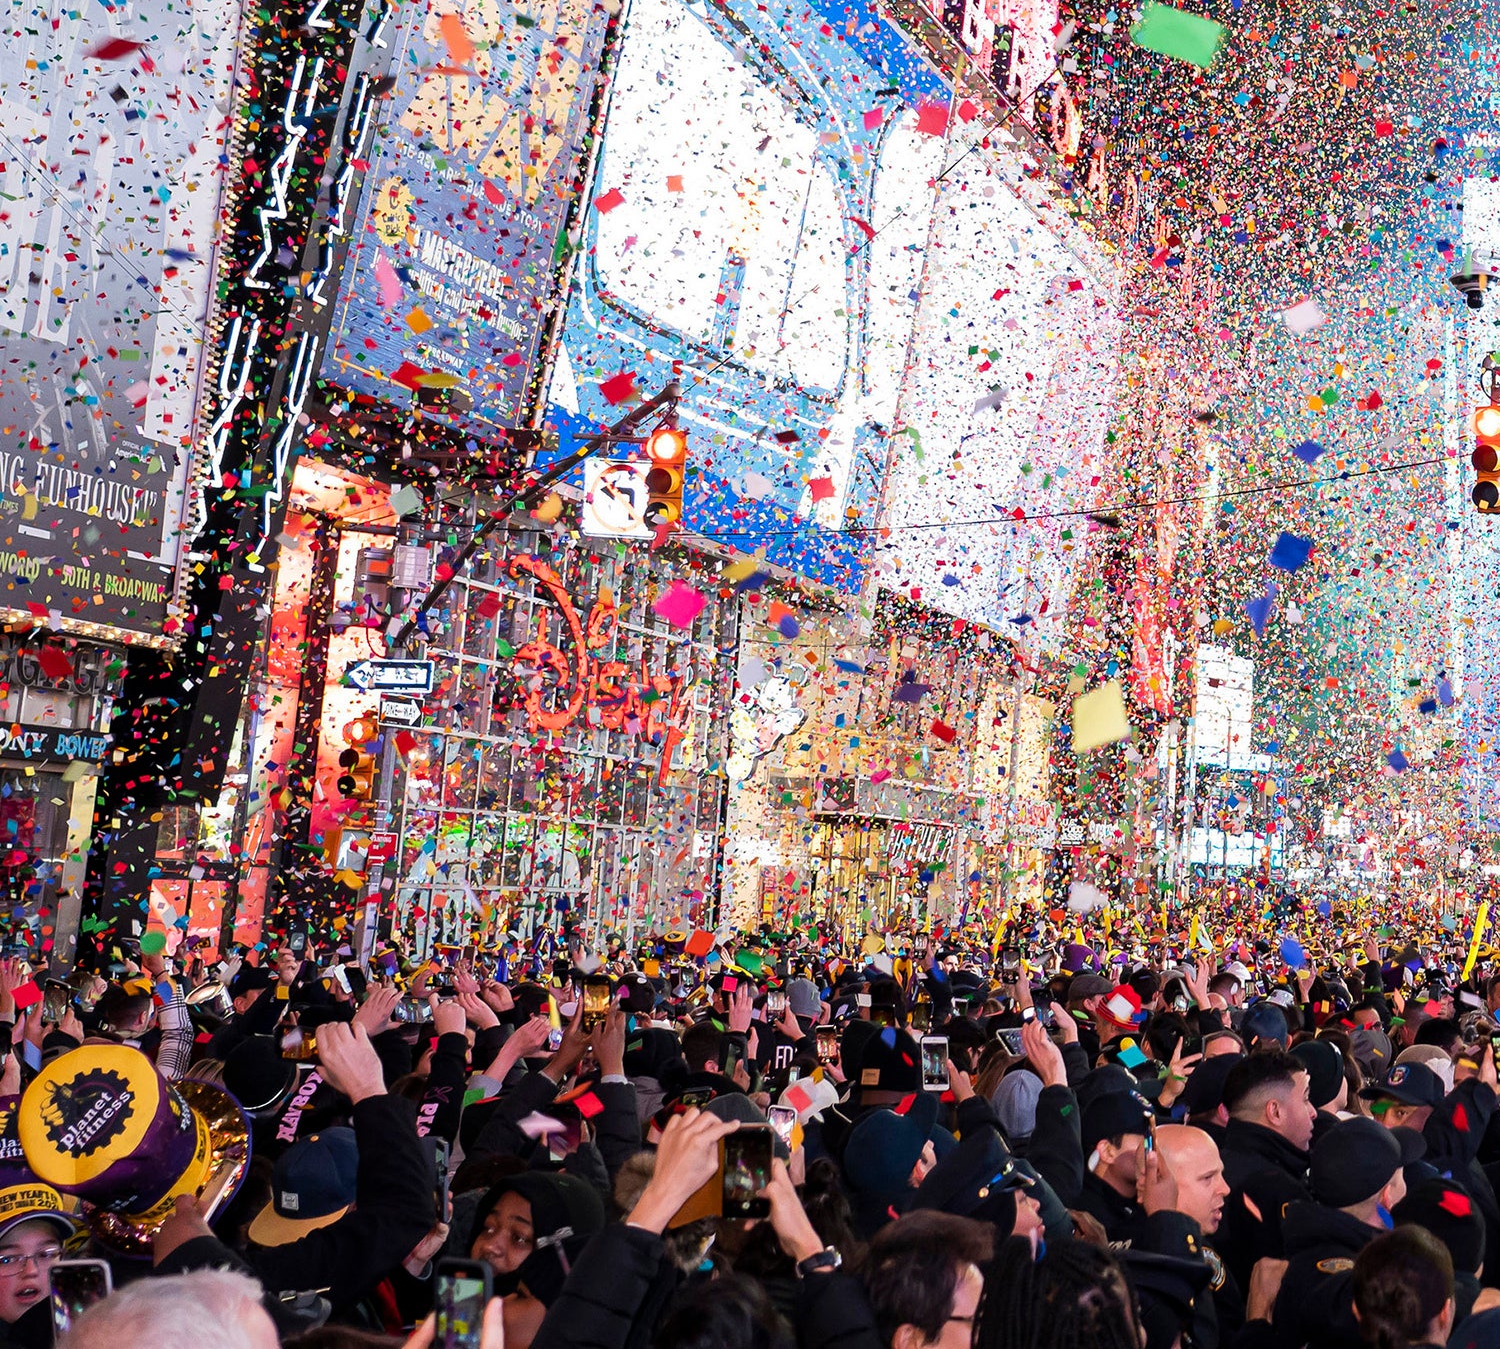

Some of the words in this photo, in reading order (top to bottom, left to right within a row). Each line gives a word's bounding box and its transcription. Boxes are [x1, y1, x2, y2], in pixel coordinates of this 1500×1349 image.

[400, 58, 564, 205] AWAY
[104, 573, 167, 604] BROADWAY
[508, 552, 695, 798] Disney
[58, 1094, 114, 1155] planet
[73, 1089, 135, 1155] fitness
[277, 1071, 325, 1144] PLAYBOY
